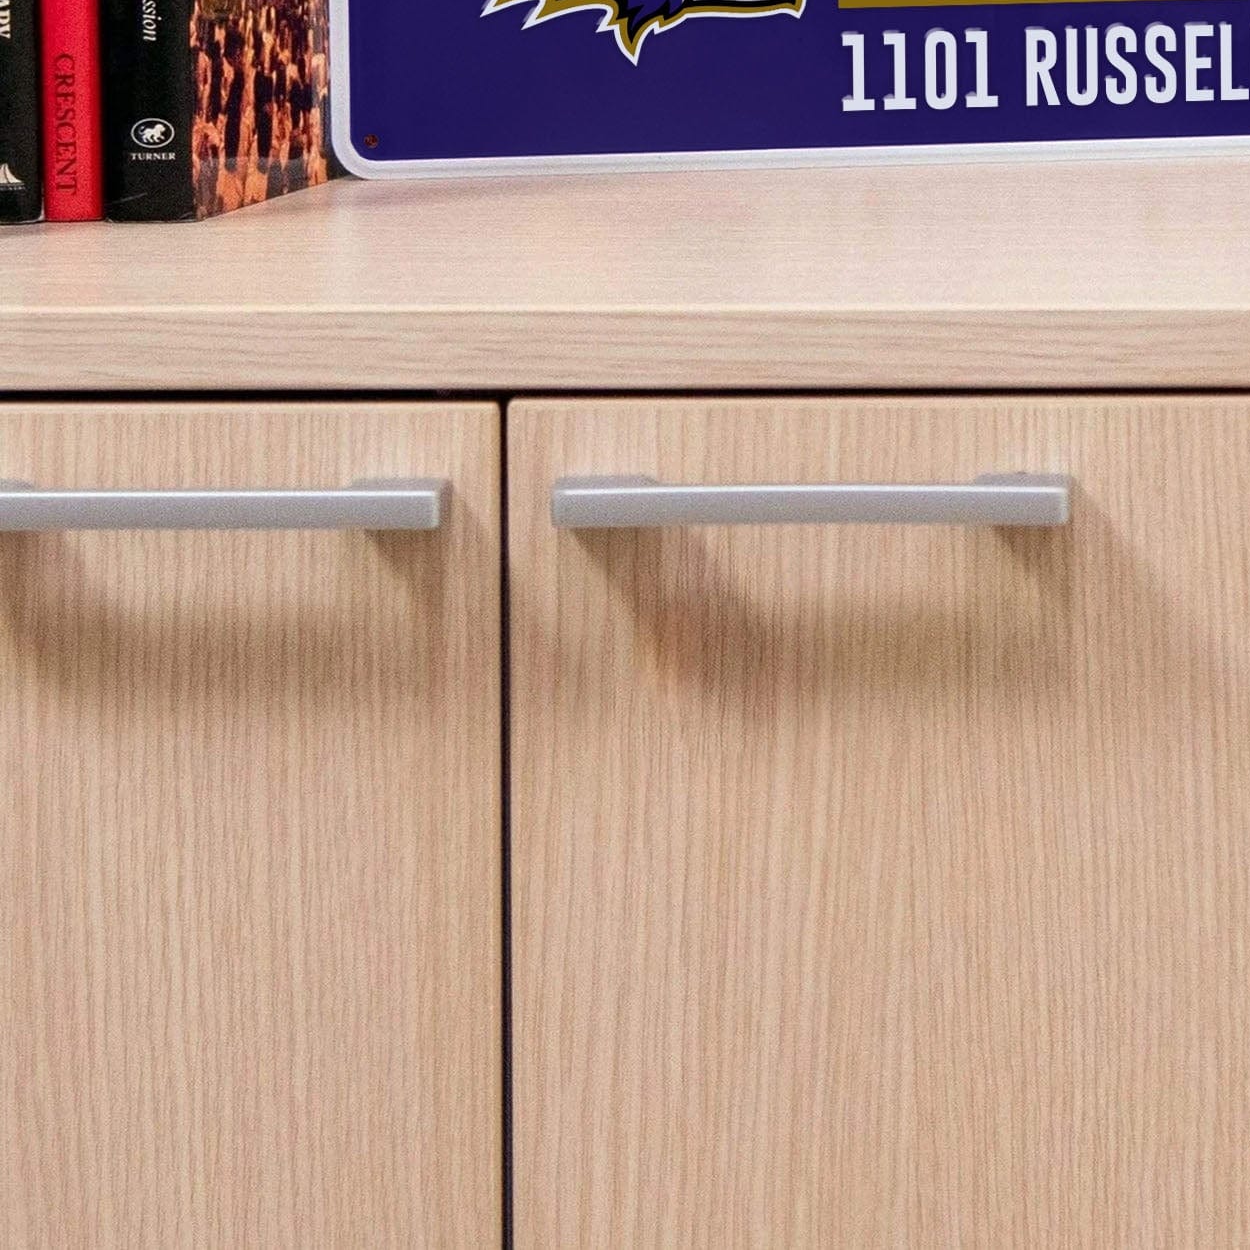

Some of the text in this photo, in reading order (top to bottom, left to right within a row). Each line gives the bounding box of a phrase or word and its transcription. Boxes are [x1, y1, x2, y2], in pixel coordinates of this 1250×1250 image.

[842, 30, 998, 111] 1101
[54, 53, 78, 196] CRESCENT
[130, 152, 176, 161] TURNER
